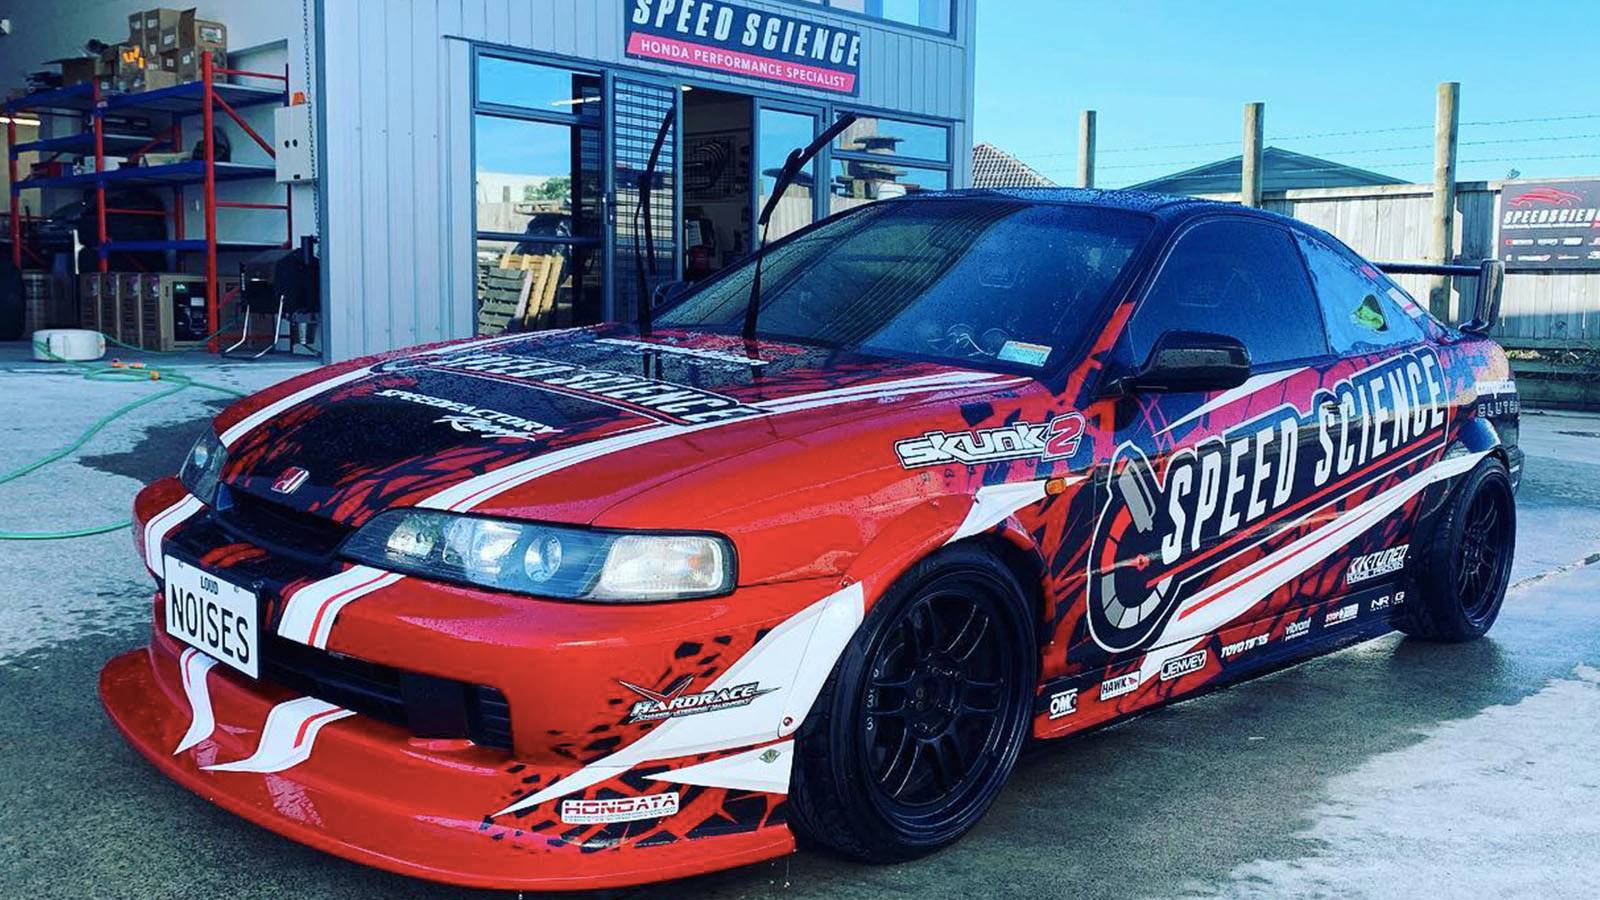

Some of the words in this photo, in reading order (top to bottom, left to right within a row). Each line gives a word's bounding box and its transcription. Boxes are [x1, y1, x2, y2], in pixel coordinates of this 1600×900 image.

[632, 0, 734, 41] SPEED
[742, 13, 860, 67] SCIENCE
[641, 39, 690, 60] HONDA
[695, 50, 782, 78] PERFORMANCE
[786, 66, 846, 88] SPECIALIST
[1161, 415, 1299, 566] SPEED
[1314, 354, 1445, 487] SCIENCE
[200, 576, 218, 595] LOUD
[171, 583, 250, 665] NOISES
[1163, 653, 1205, 677] JENVEY
[630, 682, 759, 717] HARDRACE
[1101, 678, 1127, 695] HAWK
[564, 795, 676, 815] HONDATA
